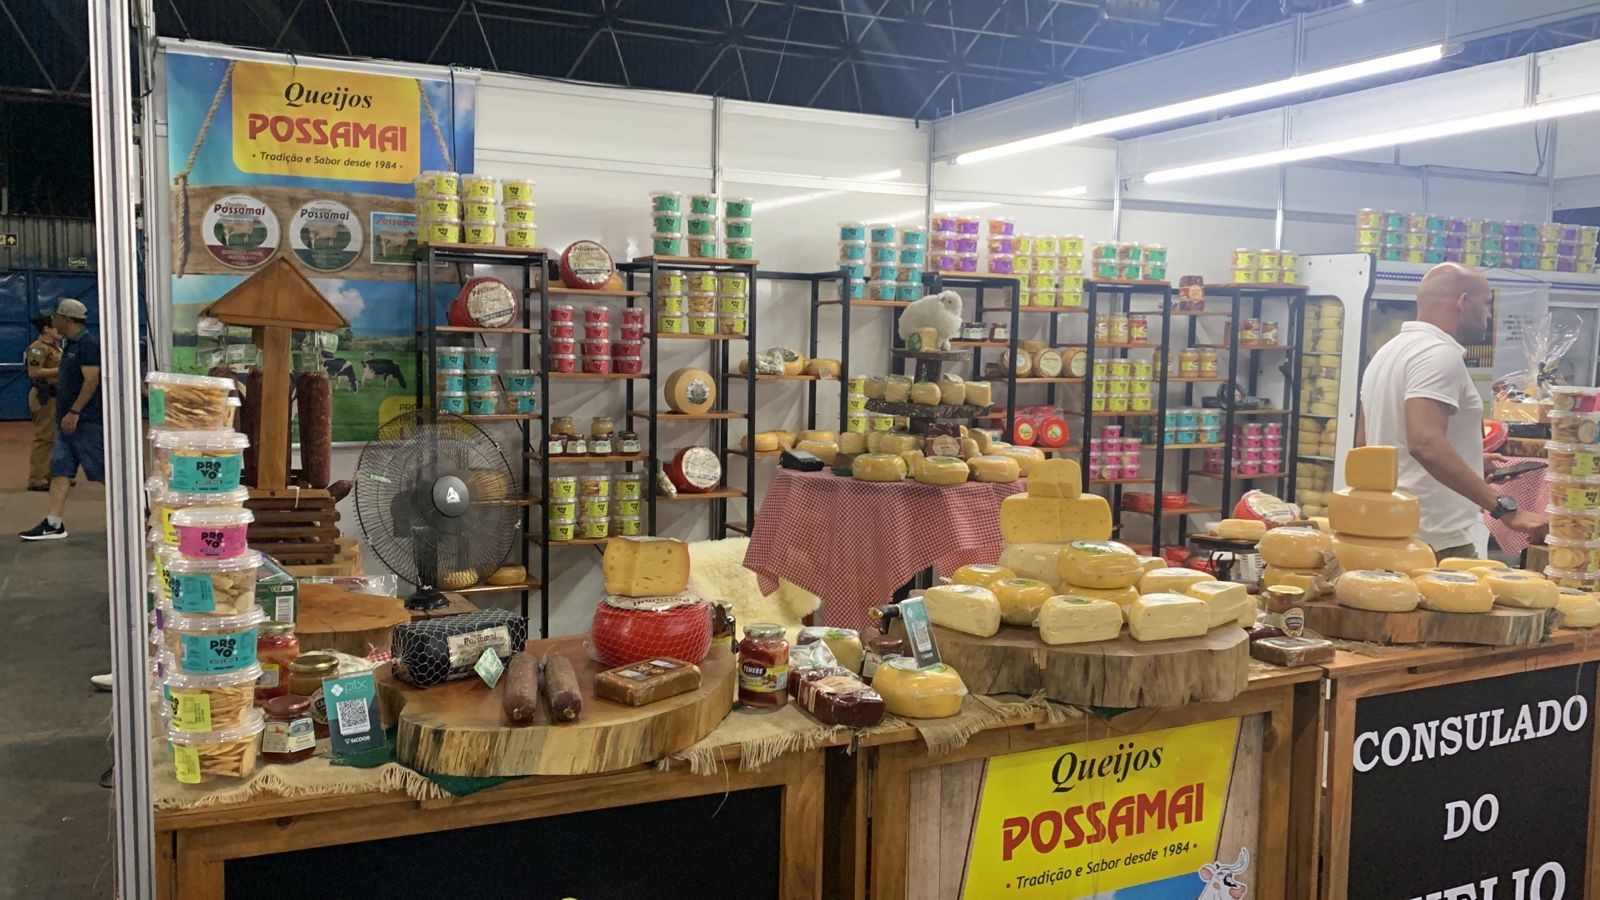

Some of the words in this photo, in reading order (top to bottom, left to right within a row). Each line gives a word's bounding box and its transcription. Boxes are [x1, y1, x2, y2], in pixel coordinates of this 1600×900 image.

[284, 82, 373, 111] Queijos
[248, 113, 407, 152] POSSAMAI
[260, 152, 303, 163] Tradição
[314, 155, 341, 166] Sabor
[344, 158, 371, 168] desde
[375, 161, 397, 169] 1984
[213, 204, 266, 215] Possamai
[300, 209, 350, 220] Possamai
[376, 217, 416, 226] Possama
[1352, 694, 1588, 772] CONSULADO
[1051, 742, 1164, 793] Queijos
[1002, 782, 1205, 861] POSSAMAI
[1443, 793, 1500, 840] DO
[1016, 868, 1072, 889] Tradição
[1075, 866, 1082, 877] e
[1087, 857, 1121, 876] Sabor
[1124, 848, 1159, 866] desde
[1162, 841, 1190, 858] 1984
